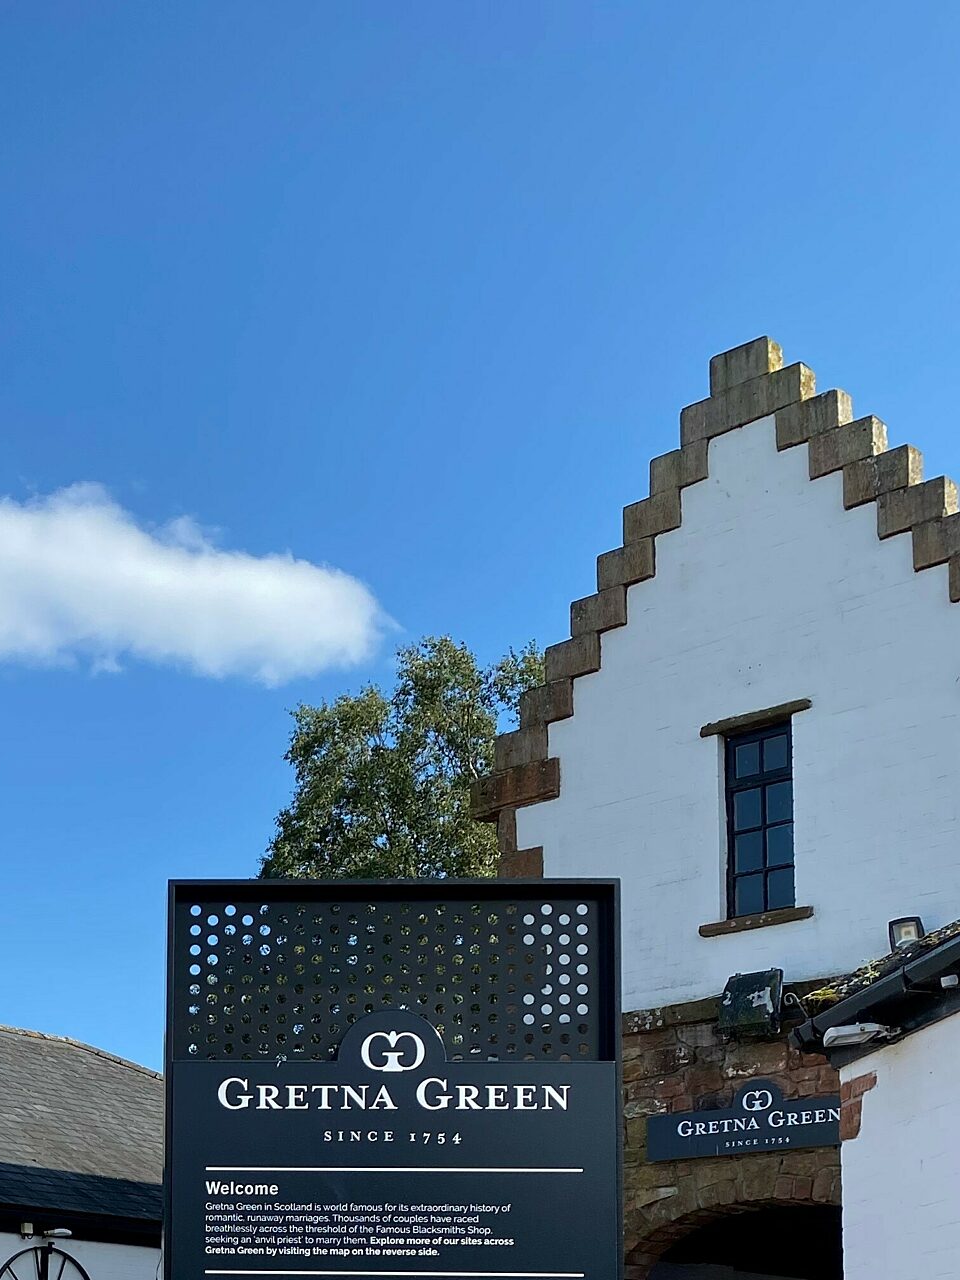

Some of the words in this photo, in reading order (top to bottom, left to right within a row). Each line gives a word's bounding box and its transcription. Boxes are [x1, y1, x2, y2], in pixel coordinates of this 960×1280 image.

[217, 1077, 398, 1110] GRETNA
[416, 1077, 571, 1111] GREEN
[677, 1117, 760, 1137] GRETNA
[768, 1107, 841, 1128] GREEN
[323, 1130, 394, 1142] SINCE
[409, 1132, 462, 1145] 1754
[725, 1139, 759, 1148] SINCE
[765, 1136, 791, 1145] 1754
[205, 1181, 279, 1195] Welcome
[206, 1202, 234, 1210] Gretna
[274, 1203, 312, 1211] Scotland
[315, 1203, 321, 1211] is
[323, 1203, 347, 1211] world
[350, 1203, 382, 1211] famous
[385, 1203, 397, 1211] for
[411, 1204, 468, 1213] extraordinary
[470, 1204, 500, 1214] history
[501, 1204, 511, 1212] of
[247, 1215, 284, 1223] runaway
[286, 1214, 330, 1224] marriages.
[332, 1214, 380, 1222] Thousands
[382, 1214, 391, 1222] of
[393, 1215, 428, 1224] couples
[454, 1215, 479, 1223] raced
[206, 1224, 257, 1234] breathlessly
[306, 1225, 346, 1233] threshold
[349, 1225, 358, 1233] of
[360, 1225, 374, 1233] the
[376, 1225, 410, 1233] Famous
[413, 1226, 466, 1234] Blacksmiths
[205, 1235, 238, 1245] seeking
[316, 1238, 341, 1246] marry
[370, 1237, 404, 1246] Explore
[461, 1237, 482, 1245] sites
[205, 1246, 235, 1254] Gretna
[237, 1246, 264, 1254] Green
[266, 1246, 277, 1256] by
[279, 1247, 310, 1256] visiting
[313, 1247, 328, 1255] the
[330, 1249, 350, 1257] map
[365, 1247, 380, 1255] the
